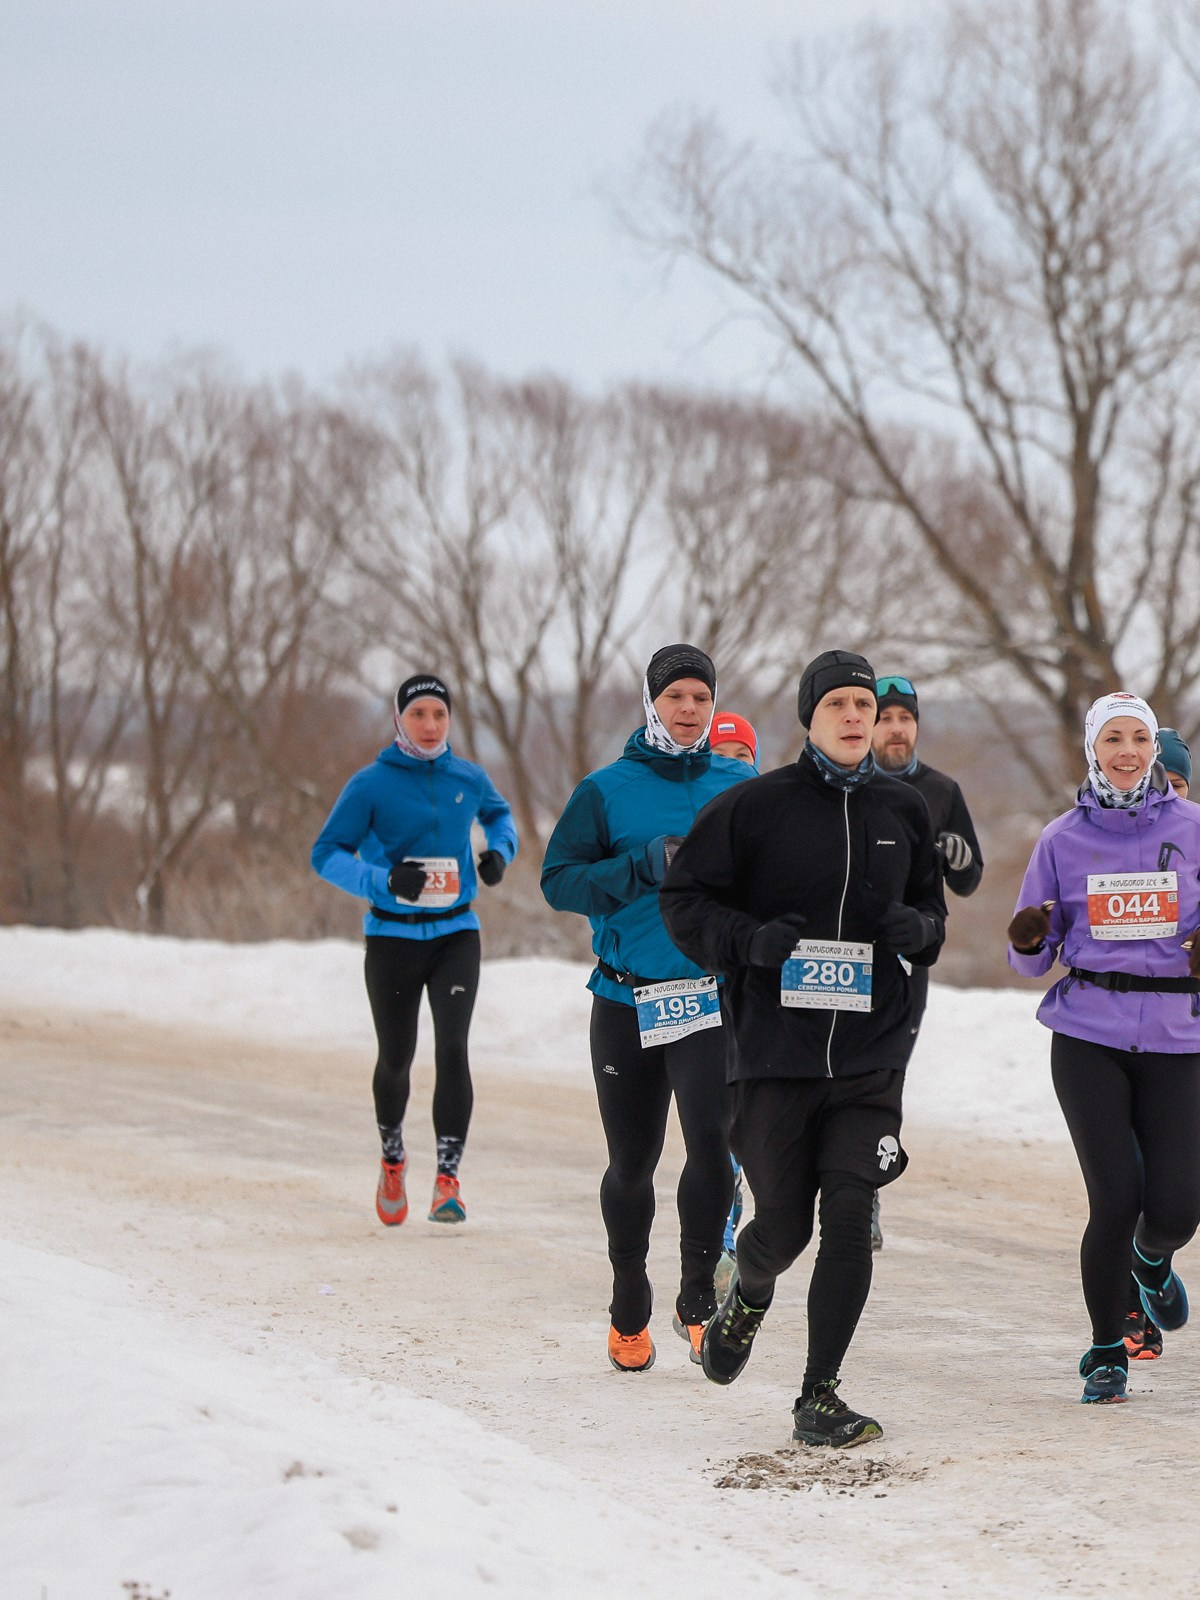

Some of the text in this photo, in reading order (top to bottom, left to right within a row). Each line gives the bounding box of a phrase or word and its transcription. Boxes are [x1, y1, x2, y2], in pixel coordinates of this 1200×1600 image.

[1107, 893, 1161, 918] 044
[805, 945, 842, 955] NOVGOROD
[802, 960, 855, 986] 280
[655, 995, 701, 1021] 195
[654, 1019, 678, 1028] ИВАНОВ
